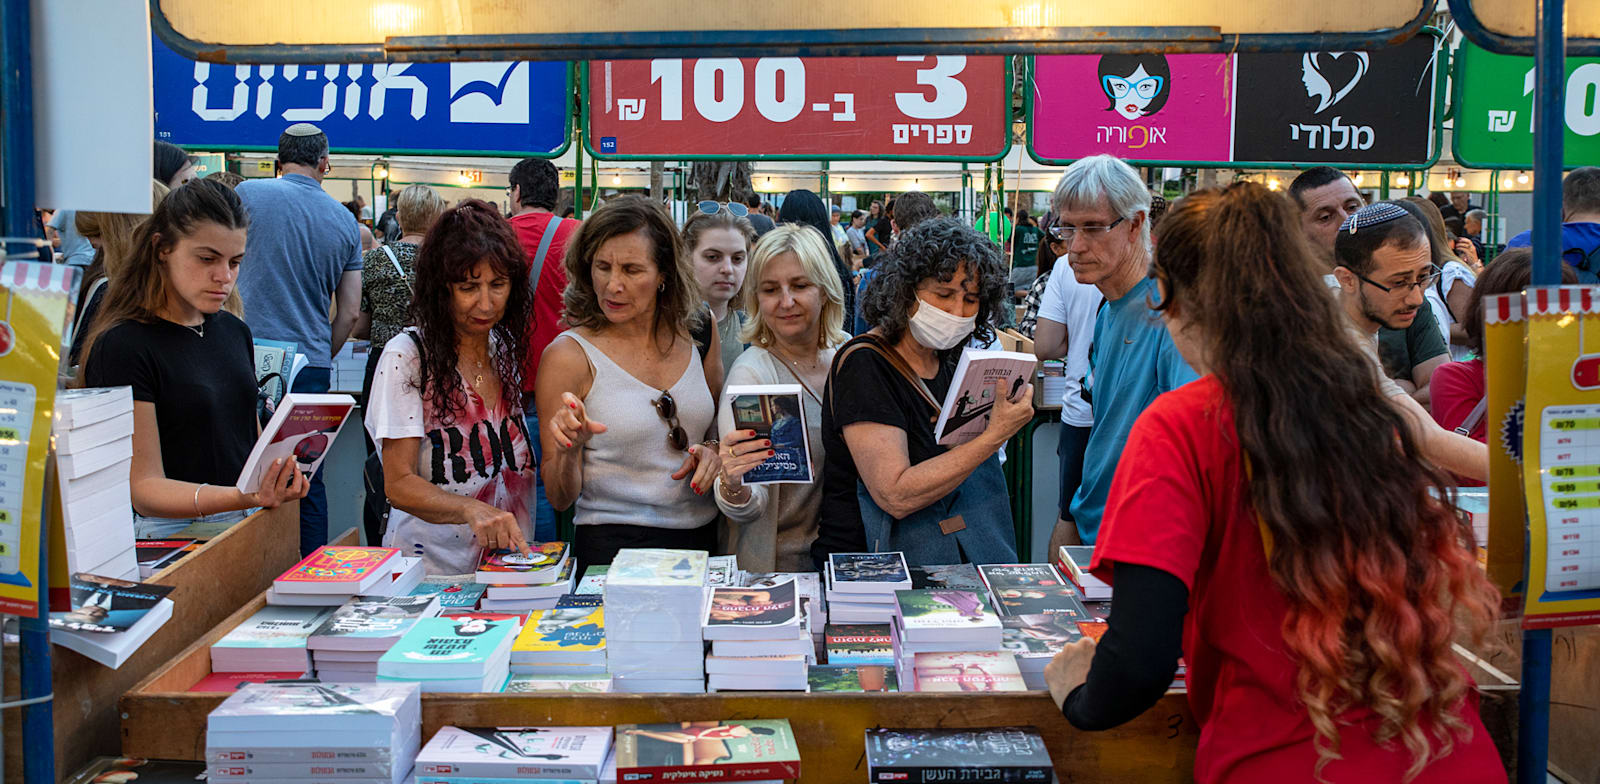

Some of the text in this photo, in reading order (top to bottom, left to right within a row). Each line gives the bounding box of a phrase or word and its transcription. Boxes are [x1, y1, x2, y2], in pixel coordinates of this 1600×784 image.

[894, 55, 967, 119] 3
[892, 124, 973, 144] ספרים
[1097, 125, 1167, 148] אופוריה
[1291, 116, 1375, 151] מלודי
[698, 770, 724, 780] נשיקה
[921, 769, 956, 783] העשן
[962, 769, 1000, 780] גבירת
